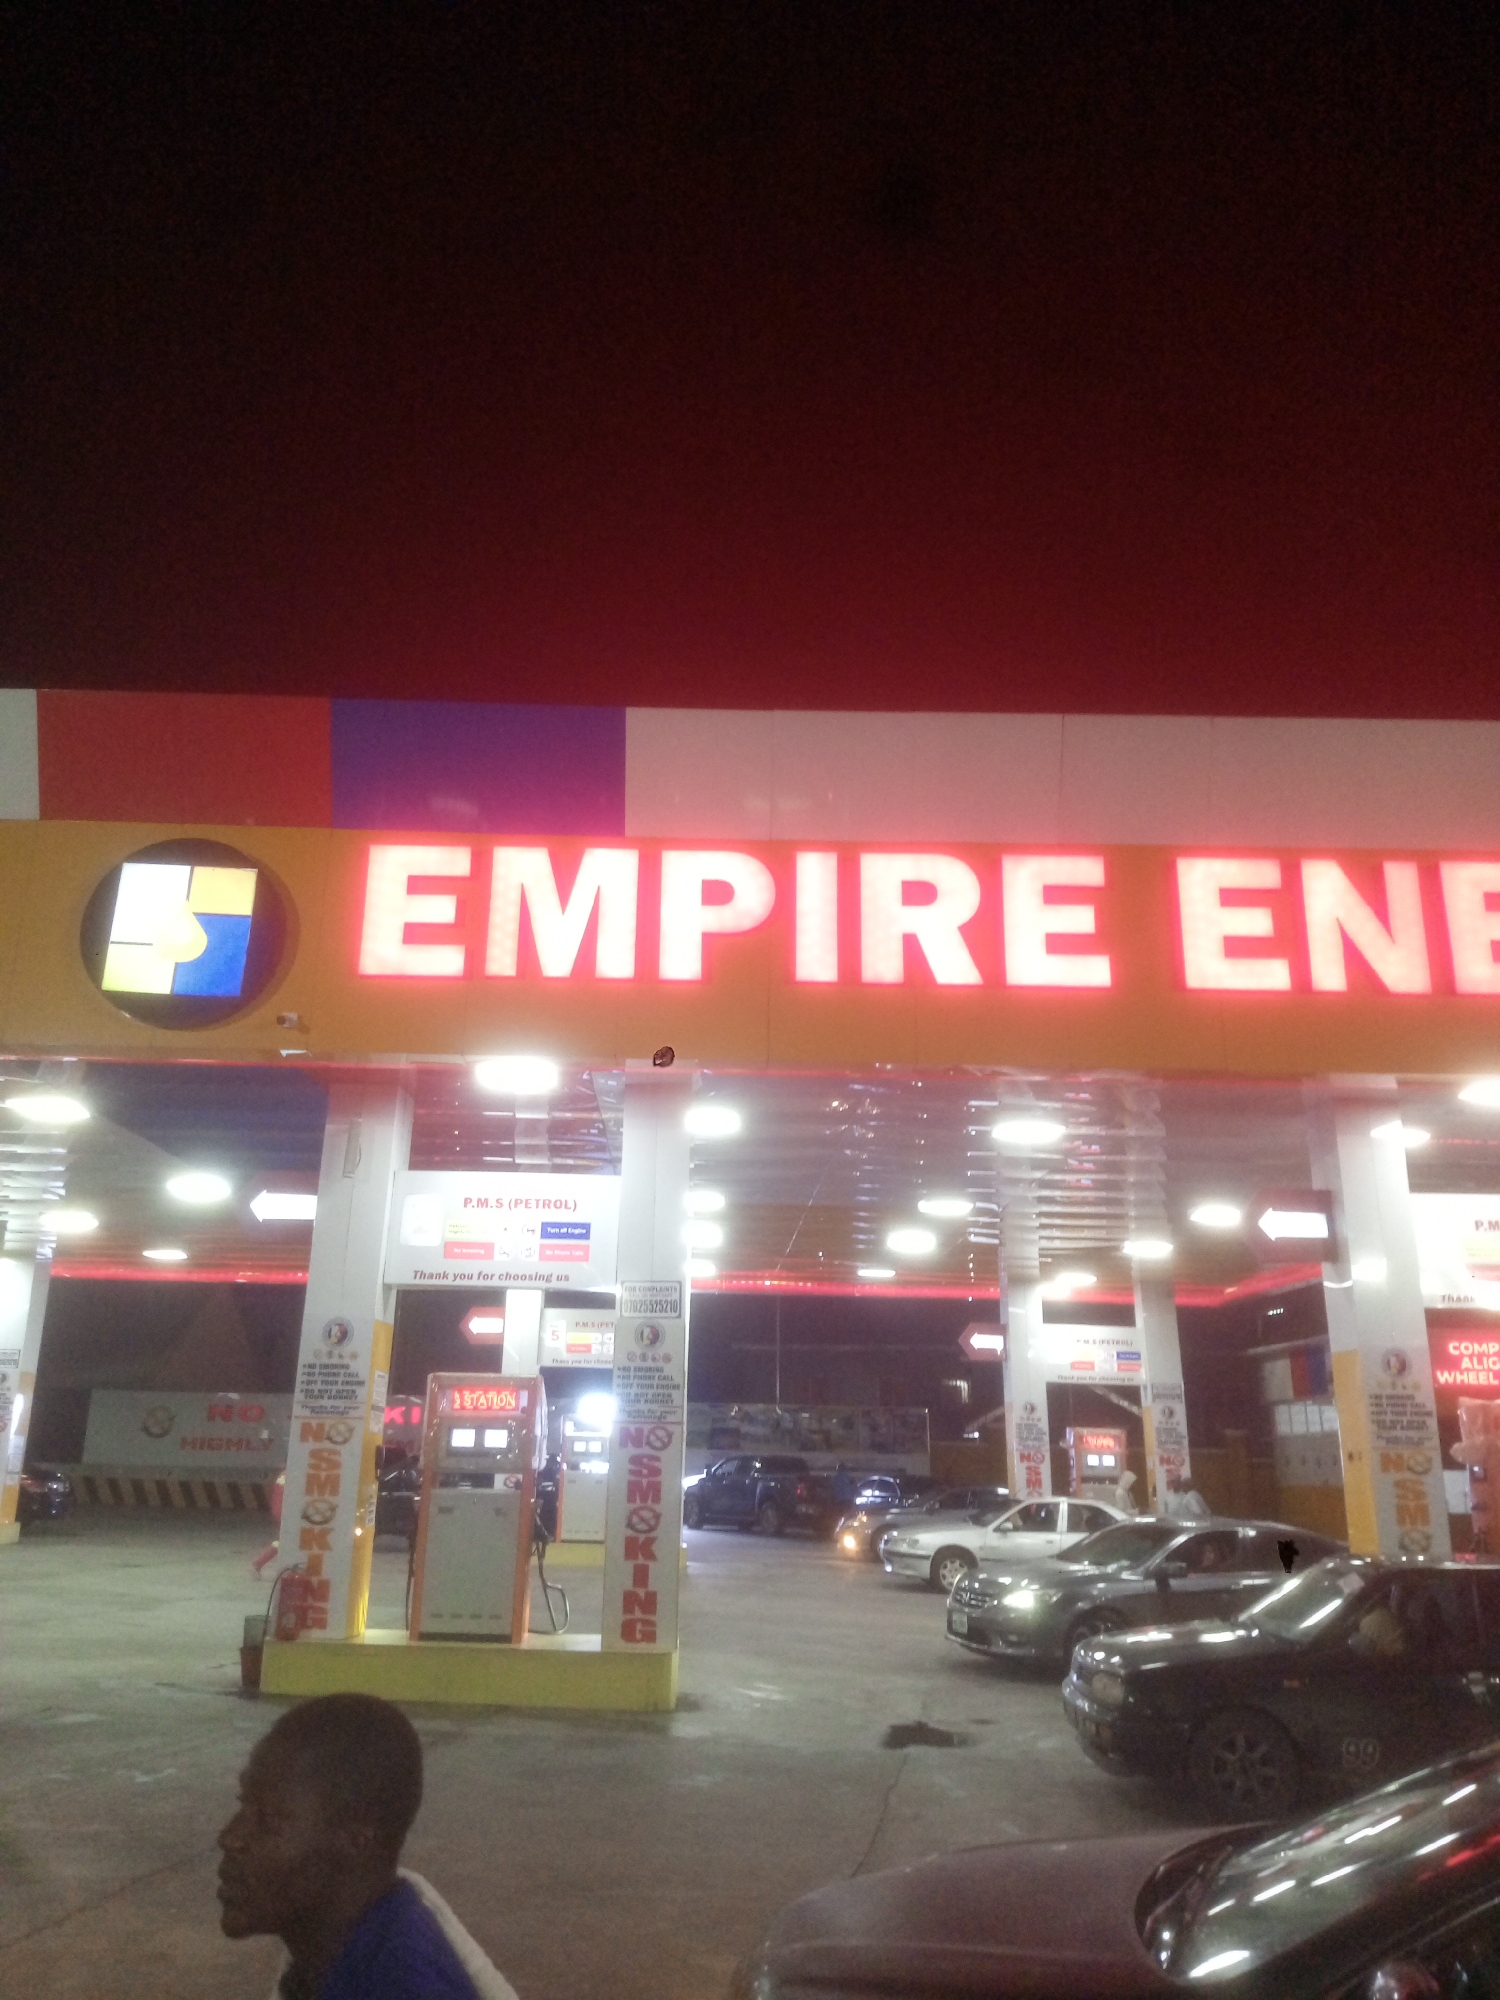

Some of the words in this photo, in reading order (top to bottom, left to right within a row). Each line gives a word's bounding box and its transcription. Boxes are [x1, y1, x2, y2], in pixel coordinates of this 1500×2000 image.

[356, 843, 1112, 988] EMPIRE
[1175, 855, 1500, 996] ENE
[463, 1196, 504, 1209] P.M.S
[508, 1198, 577, 1212] (PETROL)
[413, 1269, 450, 1280] Thank
[452, 1271, 474, 1282] you
[477, 1270, 496, 1281] for
[498, 1271, 552, 1283] choosing
[556, 1273, 569, 1281] us
[624, 1285, 637, 1293] FOR
[638, 1285, 678, 1294] COMPLAINTS
[551, 1329, 560, 1341] 5
[1448, 1341, 1500, 1356] COMP
[1461, 1355, 1500, 1370] ALIG
[1435, 1369, 1500, 1386] WHEEL
[463, 1391, 517, 1407] STATION
[207, 1404, 265, 1422] NO
